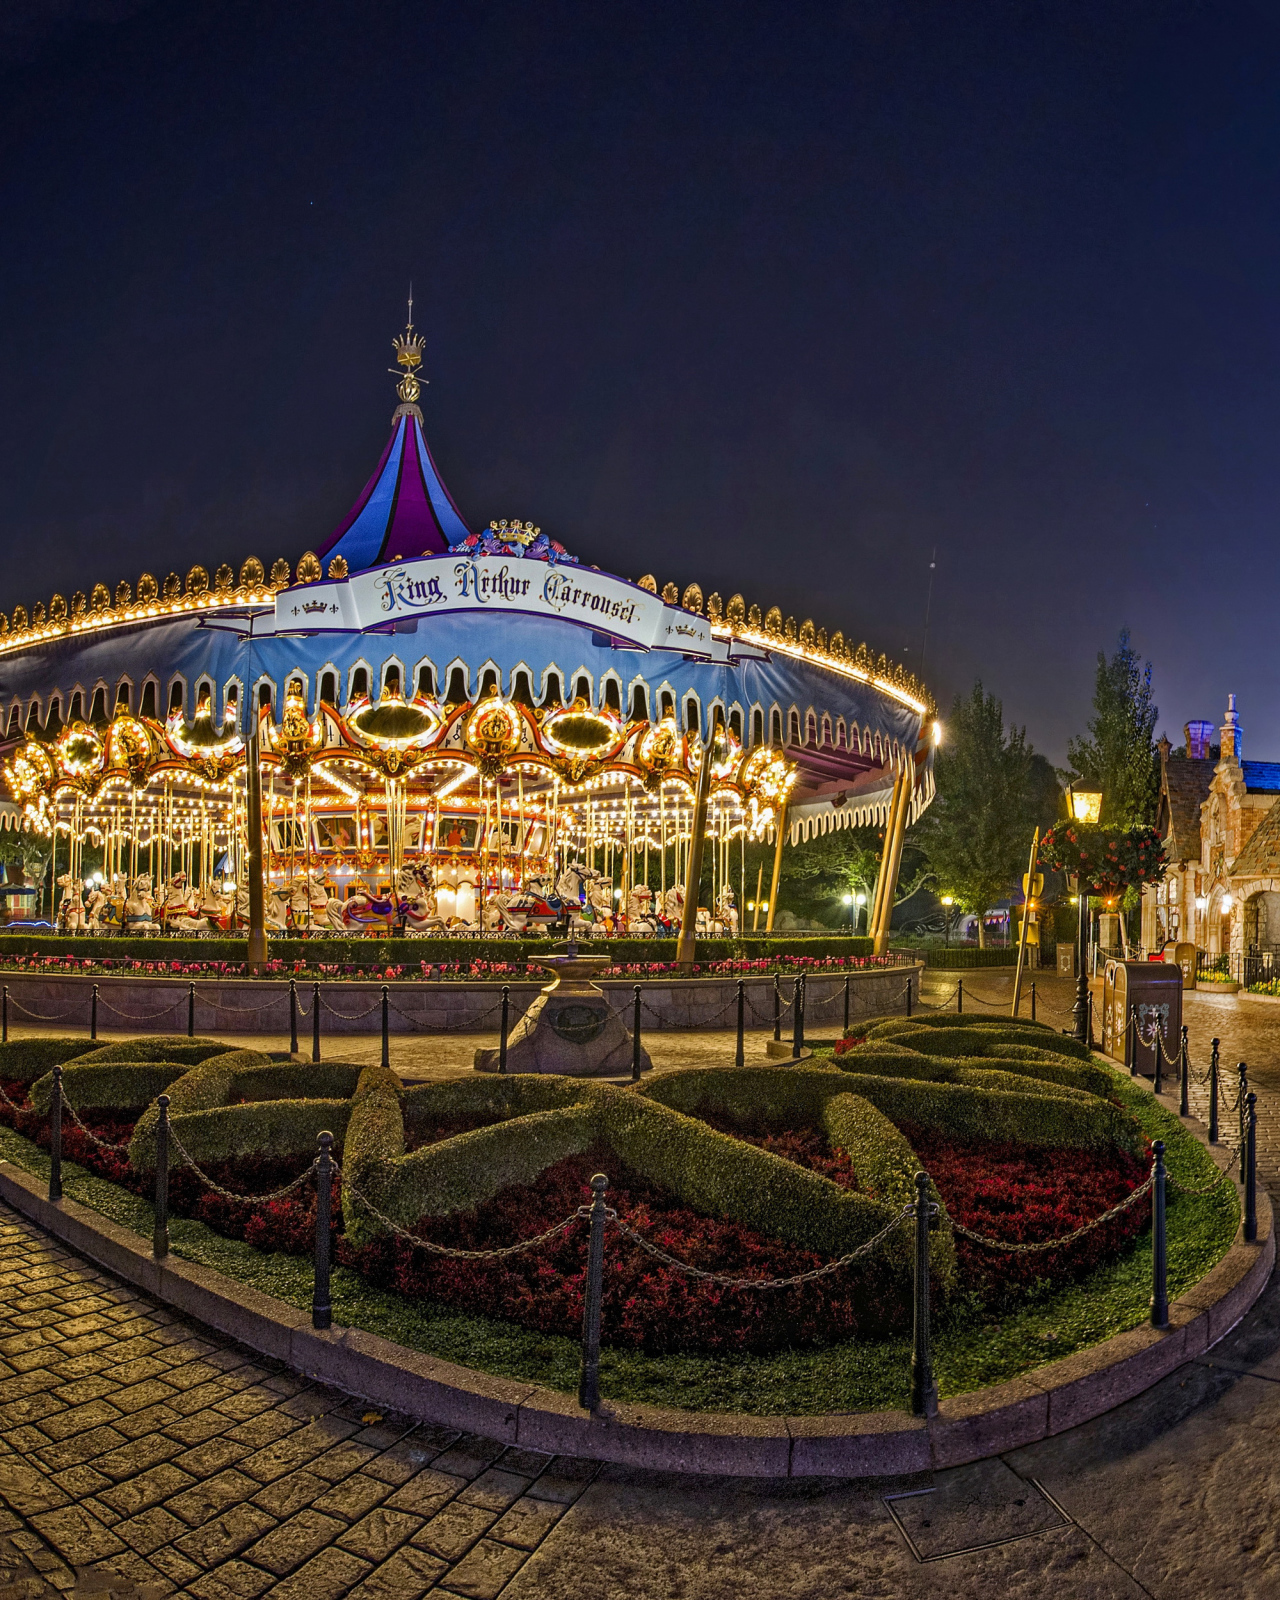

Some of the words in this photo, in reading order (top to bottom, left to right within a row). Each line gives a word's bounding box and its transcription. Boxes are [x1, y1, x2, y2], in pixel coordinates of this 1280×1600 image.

[375, 568, 447, 611] King
[454, 561, 530, 603] Arthur
[540, 569, 643, 623] Carrousel
